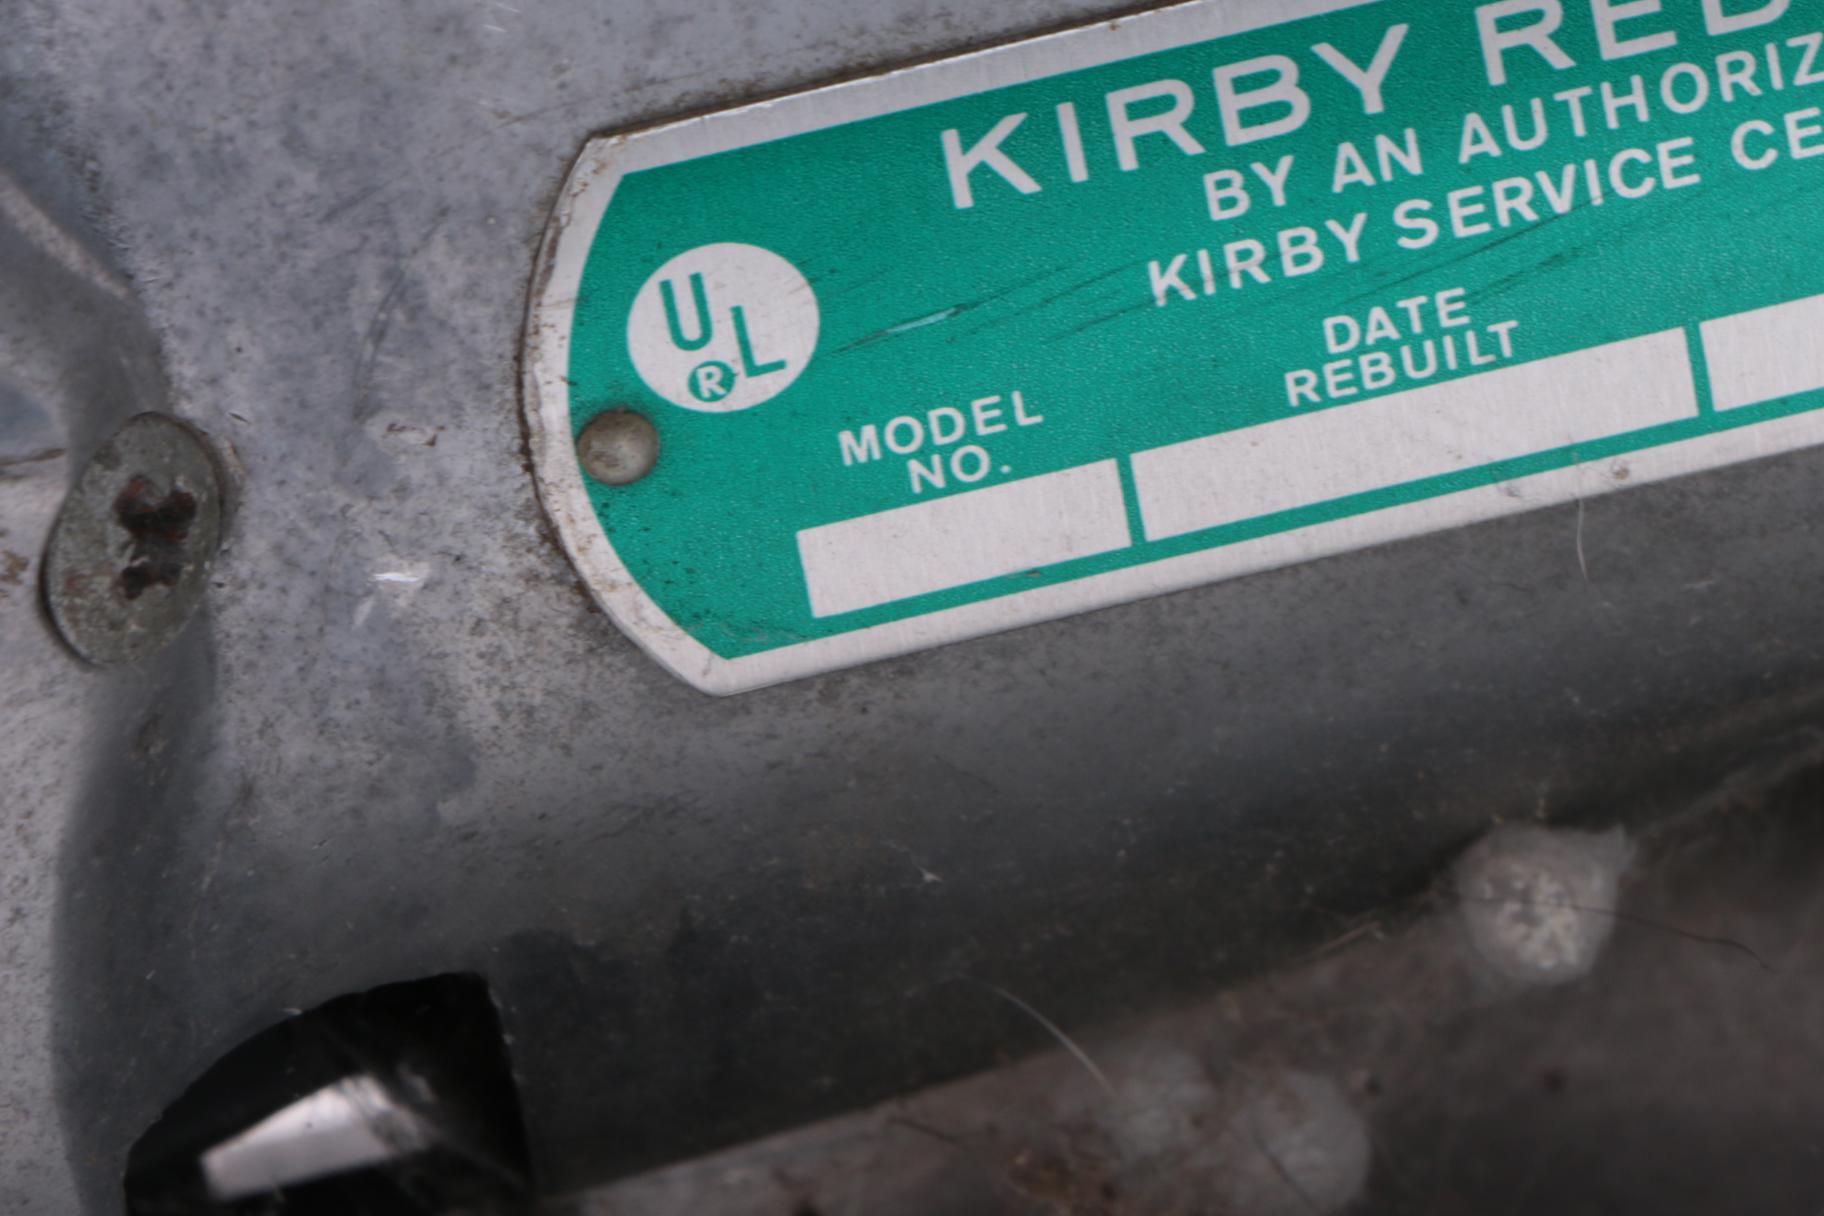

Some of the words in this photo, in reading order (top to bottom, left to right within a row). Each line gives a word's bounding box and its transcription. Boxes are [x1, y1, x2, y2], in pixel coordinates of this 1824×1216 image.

[940, 22, 1409, 210] KIRBY
[1203, 157, 1297, 221] BY
[1330, 128, 1423, 194] AN
[1148, 212, 1369, 306] KIRBY
[1397, 137, 1700, 249] SERVICE
[1283, 321, 1519, 407] REBUILT
[1322, 288, 1469, 354] DATE
[837, 391, 1044, 466] MODEL
[908, 445, 1011, 493] NO.
